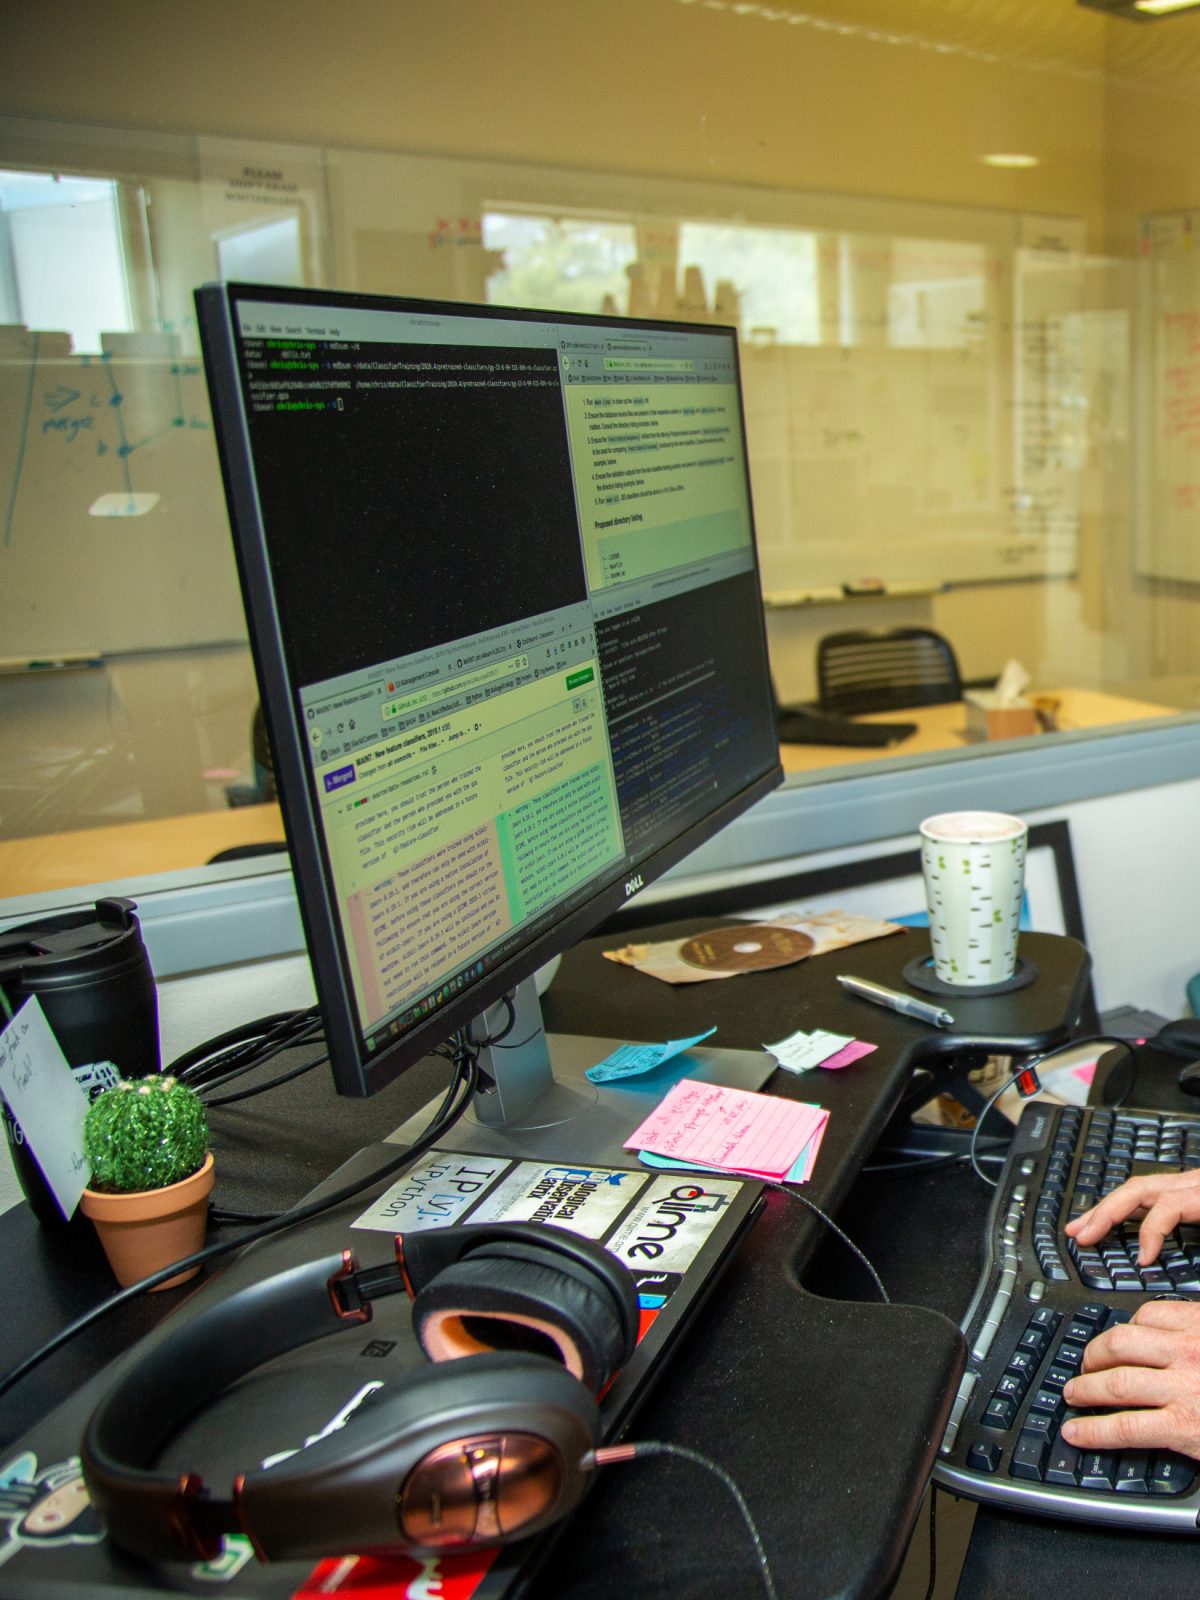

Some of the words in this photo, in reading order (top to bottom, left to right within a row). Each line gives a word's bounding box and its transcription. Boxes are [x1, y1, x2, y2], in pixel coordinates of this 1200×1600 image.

[594, 518, 613, 530] Proposed
[374, 747, 385, 759] New
[385, 741, 402, 754] feature
[624, 874, 645, 896] DELL
[380, 1163, 451, 1218] IPython
[529, 1173, 589, 1224] Observatio
